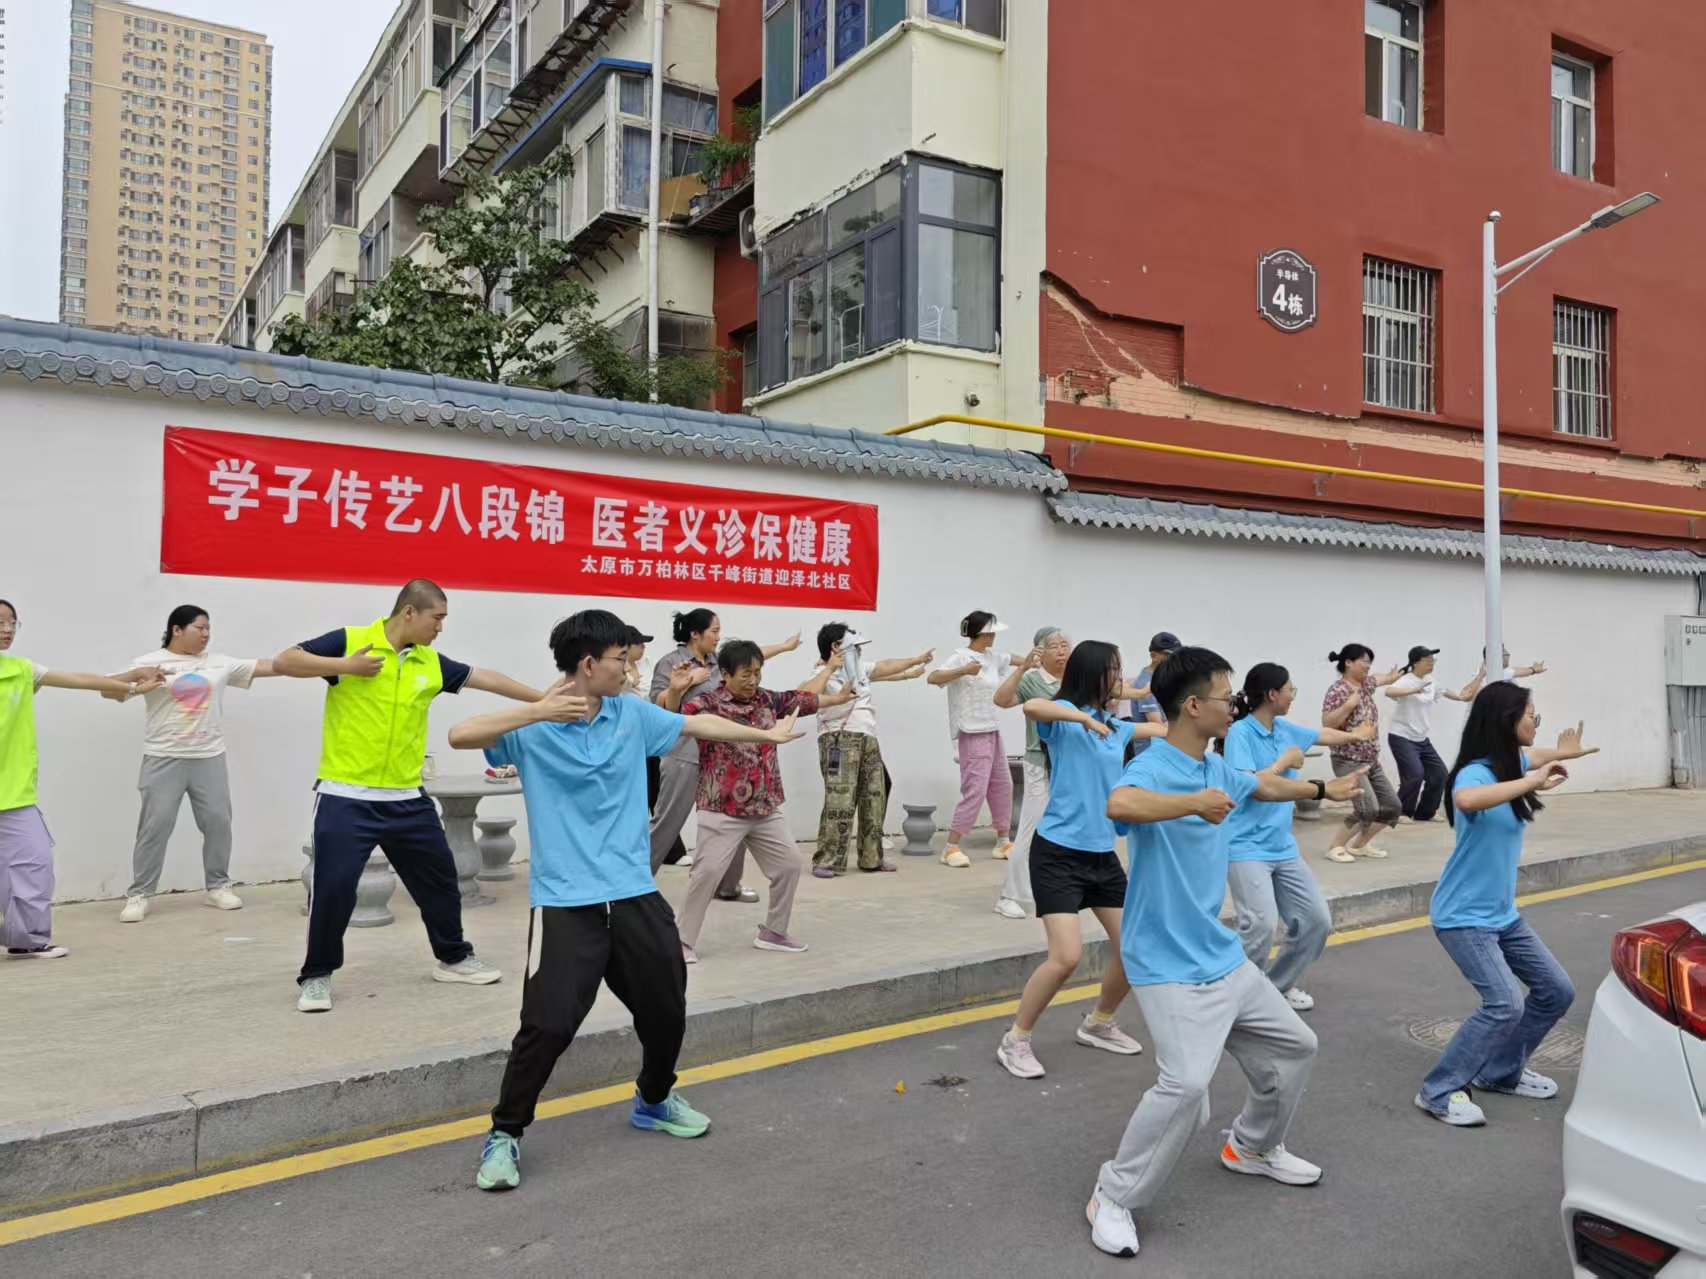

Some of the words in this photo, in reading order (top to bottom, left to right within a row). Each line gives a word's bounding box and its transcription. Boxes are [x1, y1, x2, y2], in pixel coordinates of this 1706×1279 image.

[1272, 283, 1304, 316] 4栋
[208, 458, 565, 545] 学子传艺八段锦
[592, 496, 851, 567] 医者义诊保健康
[581, 554, 851, 590] 太原市万柏林区千峰街道迎泽北社区
